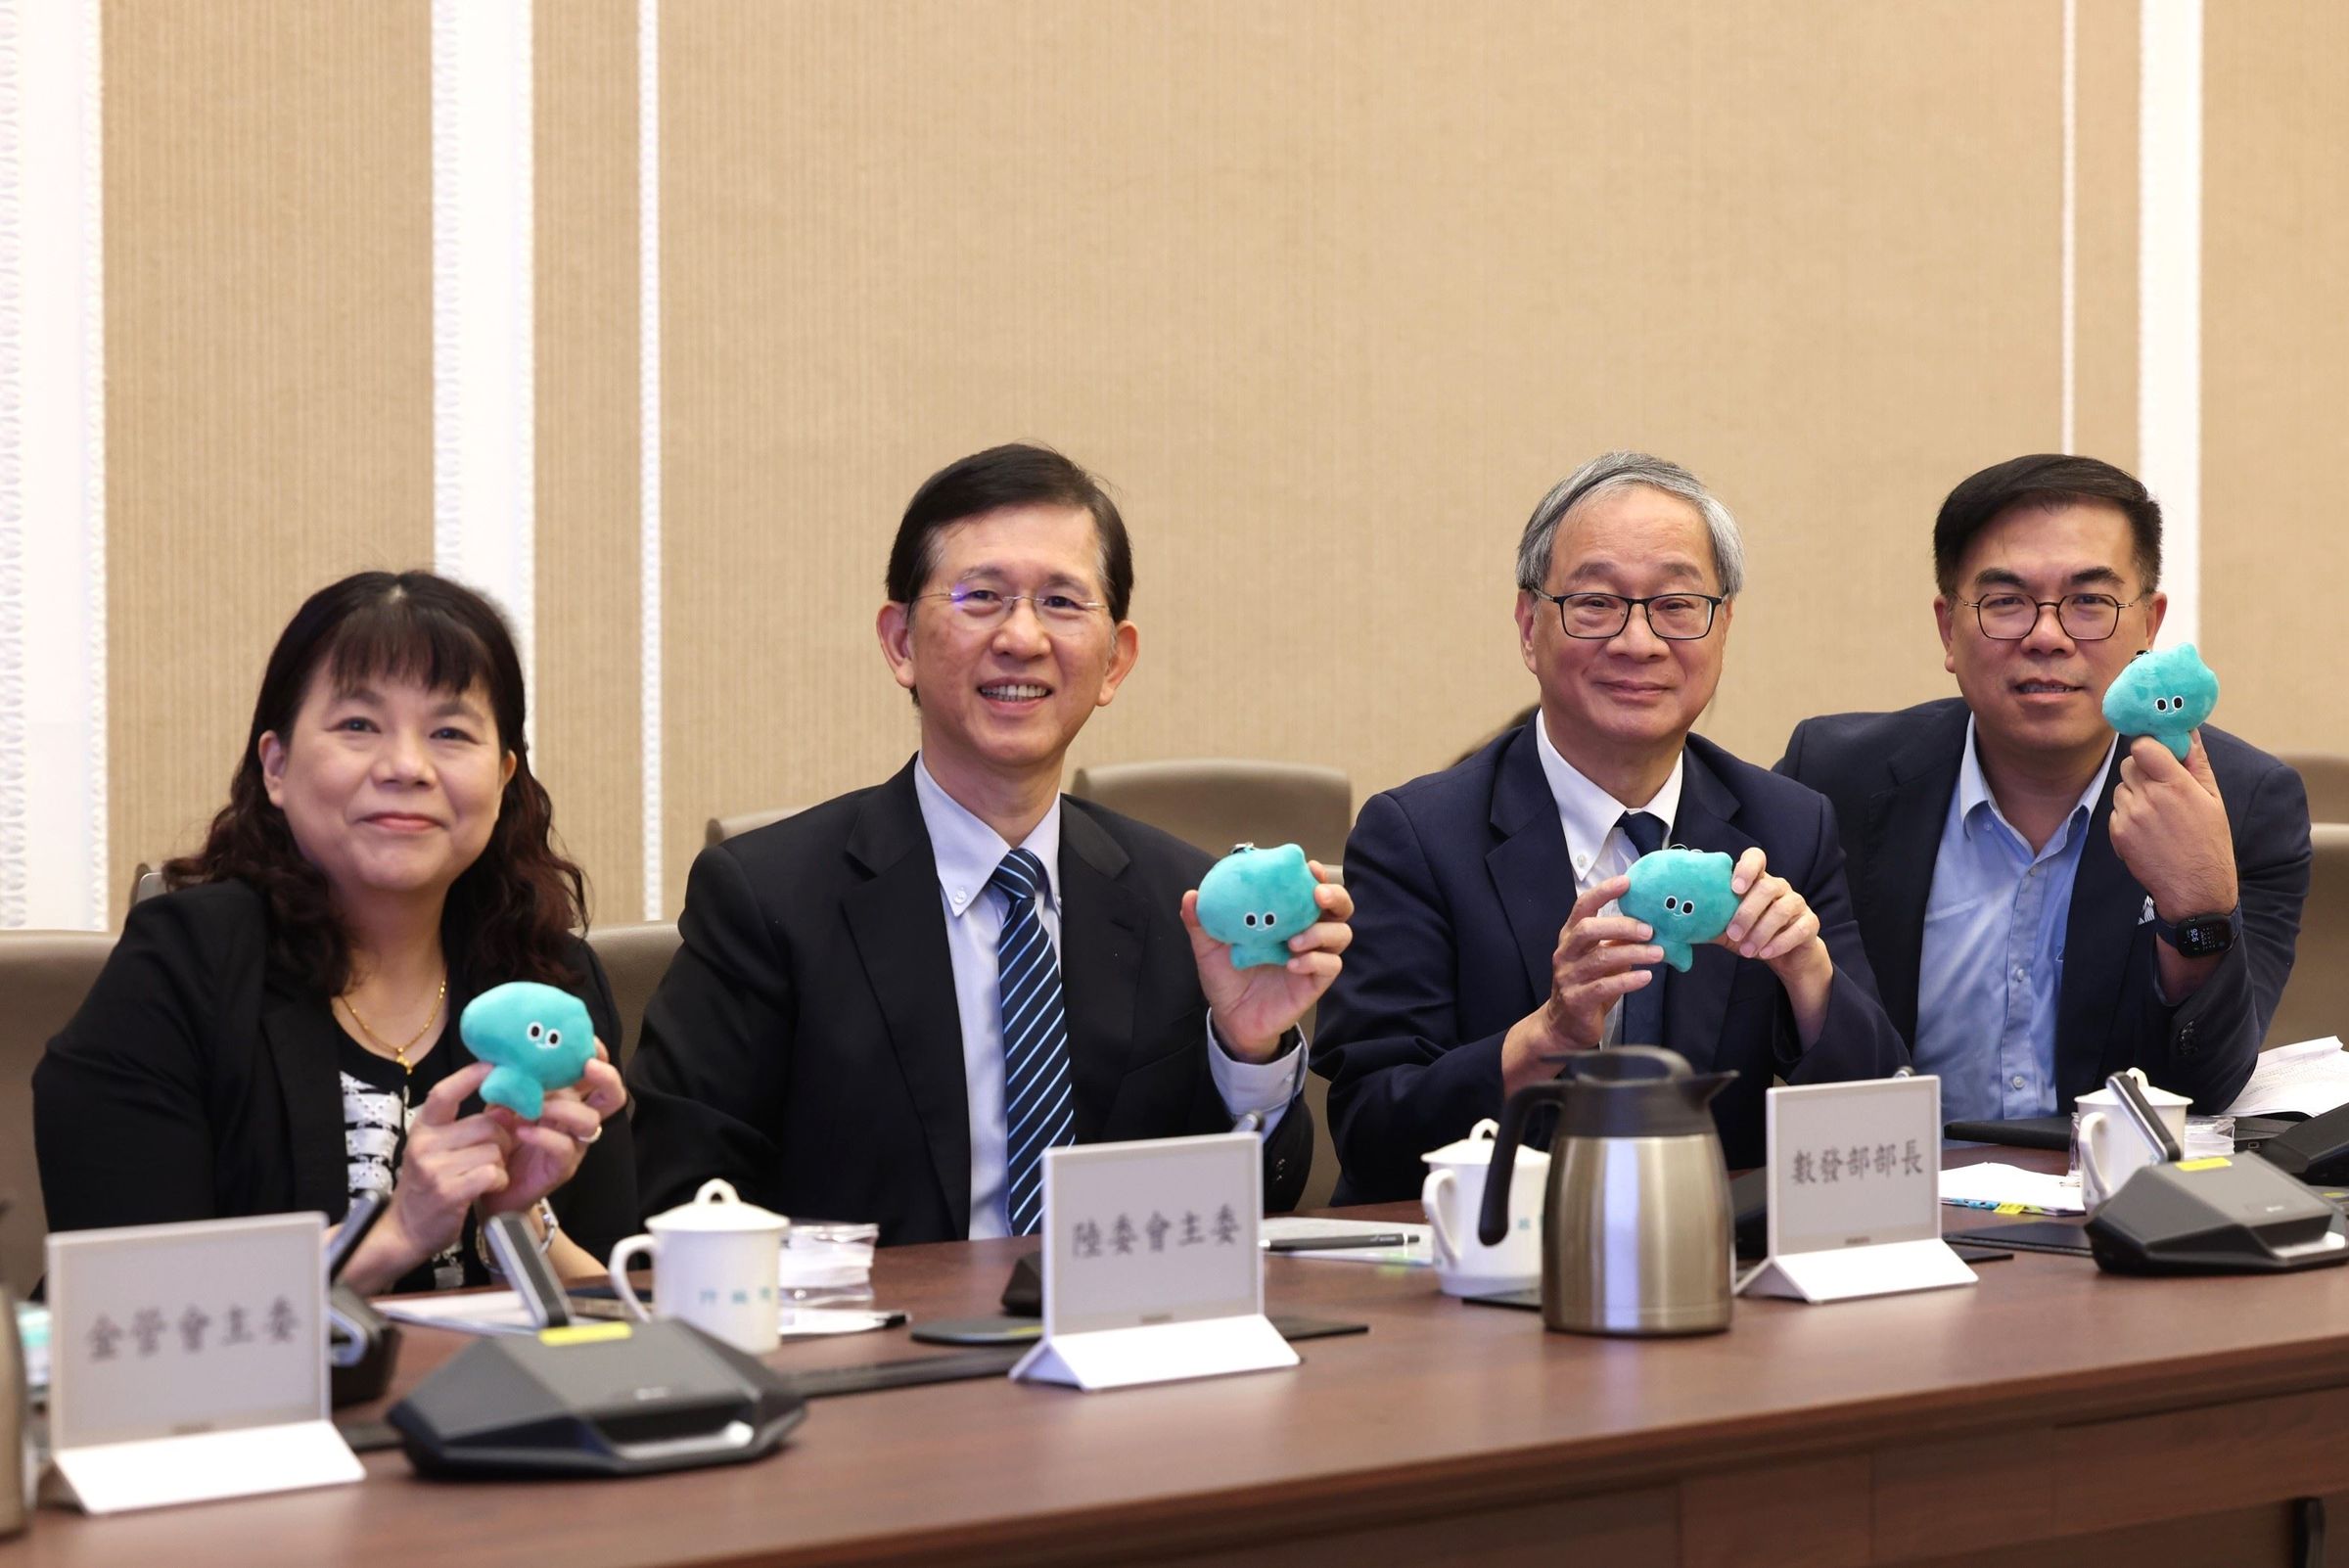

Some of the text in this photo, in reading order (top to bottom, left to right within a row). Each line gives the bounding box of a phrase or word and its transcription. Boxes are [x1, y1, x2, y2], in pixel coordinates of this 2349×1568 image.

[1791, 1138, 1923, 1184] 數發部部長
[1072, 1204, 1242, 1259] 陸委會主委
